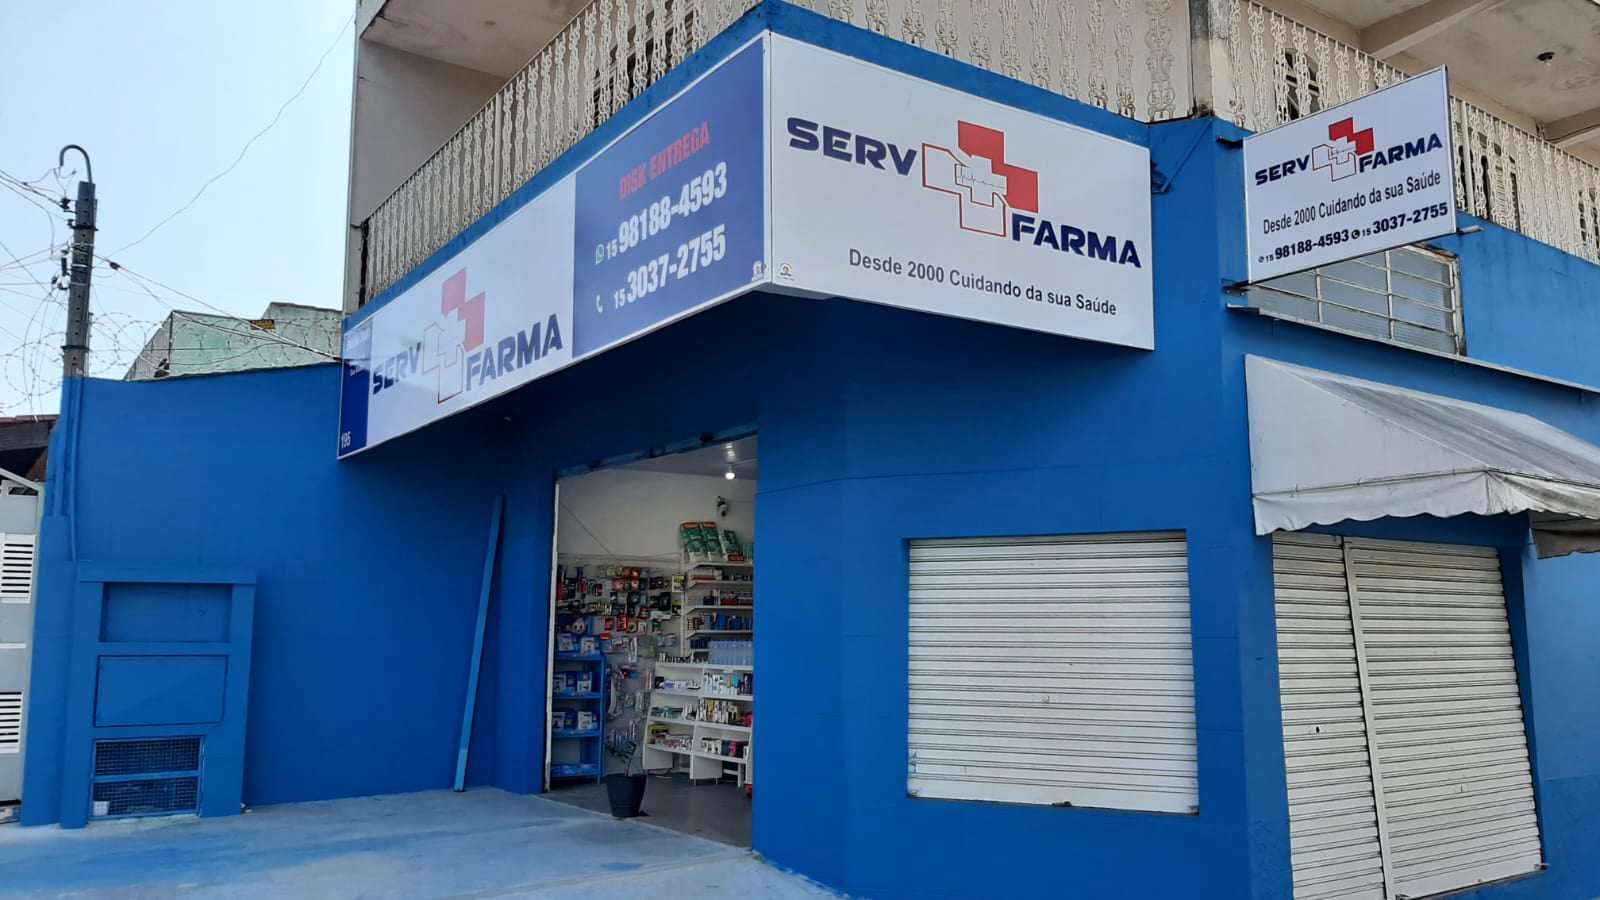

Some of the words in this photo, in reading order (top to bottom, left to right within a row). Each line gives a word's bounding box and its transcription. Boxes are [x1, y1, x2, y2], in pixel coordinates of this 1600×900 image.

[619, 161, 646, 200] DISK
[651, 121, 710, 180] ENTREGA
[787, 117, 917, 176] SERV
[1012, 213, 1142, 269] FARMA
[1255, 154, 1310, 186] SERV
[1359, 133, 1443, 173] FARMA
[606, 239, 617, 260] 15
[618, 161, 728, 253] 98188-4593
[1263, 213, 1292, 234] Desde
[1294, 205, 1316, 226] 2000
[1318, 191, 1366, 218] Cuidando
[1369, 187, 1382, 204] da
[1385, 182, 1404, 200] sua
[1406, 169, 1441, 193] Saúde
[1274, 229, 1350, 260] 98188-4593
[1361, 228, 1371, 237] 15
[1373, 202, 1448, 234] 3037-2755
[614, 287, 625, 309] 15
[627, 223, 726, 303] 3037-2755
[849, 248, 902, 275] Desde
[907, 260, 944, 283] 2000
[949, 269, 1021, 298] Cuidando
[1025, 284, 1043, 301] da
[1046, 291, 1072, 307] sua
[1075, 294, 1117, 316] Saúde
[373, 341, 421, 395] SERV
[466, 313, 563, 391] FARMA
[341, 431, 351, 449] 195
